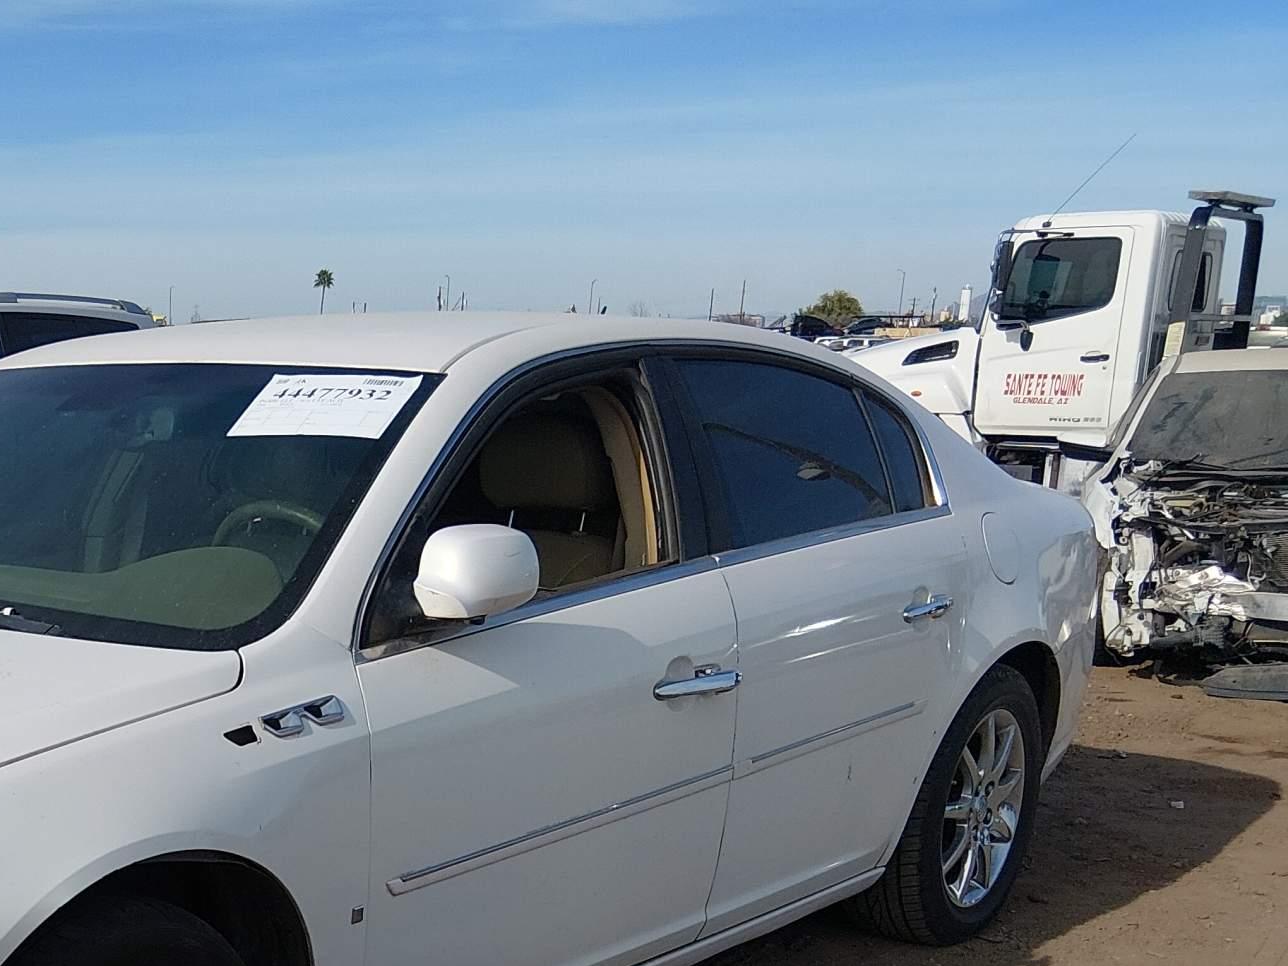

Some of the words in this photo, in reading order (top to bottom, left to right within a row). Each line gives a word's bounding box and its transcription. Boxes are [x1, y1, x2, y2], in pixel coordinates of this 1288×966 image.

[273, 387, 392, 400] 44477932
[1003, 373, 1034, 396] SANTE
[1034, 373, 1048, 395] FE
[1049, 373, 1085, 396] TOWING
